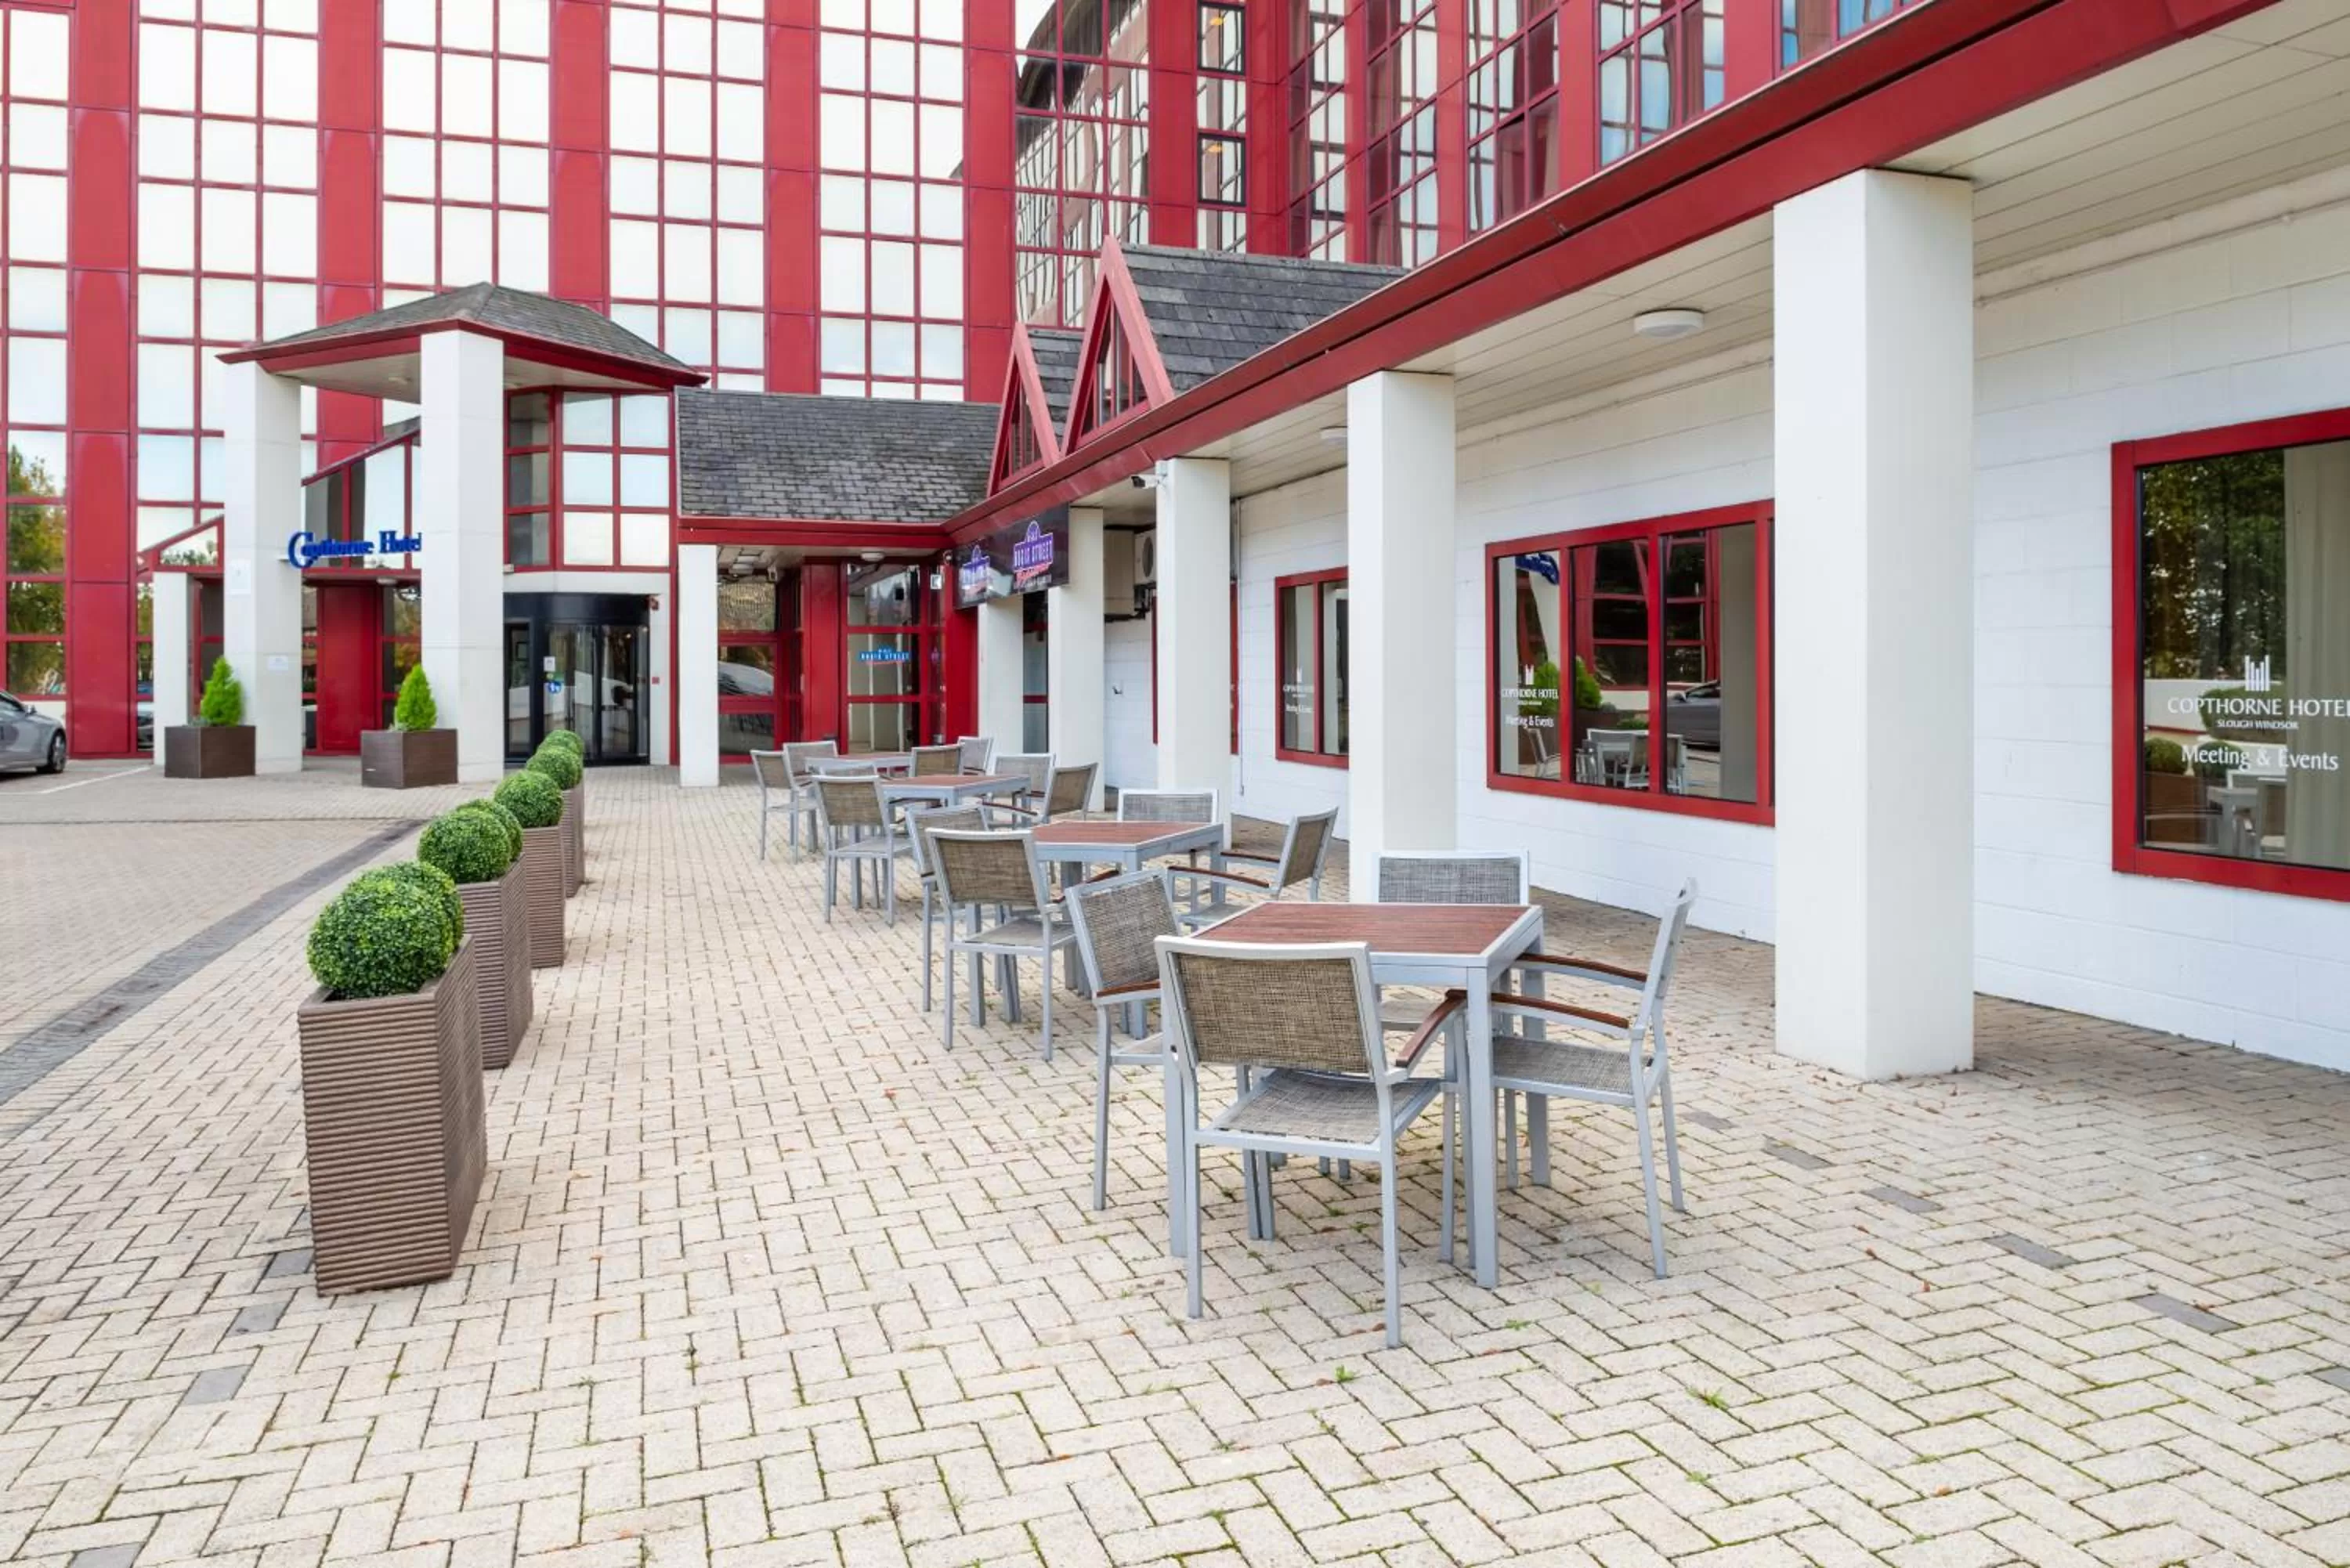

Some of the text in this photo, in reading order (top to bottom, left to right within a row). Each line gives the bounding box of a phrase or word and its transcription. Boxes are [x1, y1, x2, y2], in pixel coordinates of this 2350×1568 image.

[1538, 688, 1559, 699] HOTEL
[2167, 697, 2283, 715] COPTHORNE
[2217, 719, 2300, 729] SLOUGH WINDSOR
[2182, 745, 2338, 771] Meeting & Events
